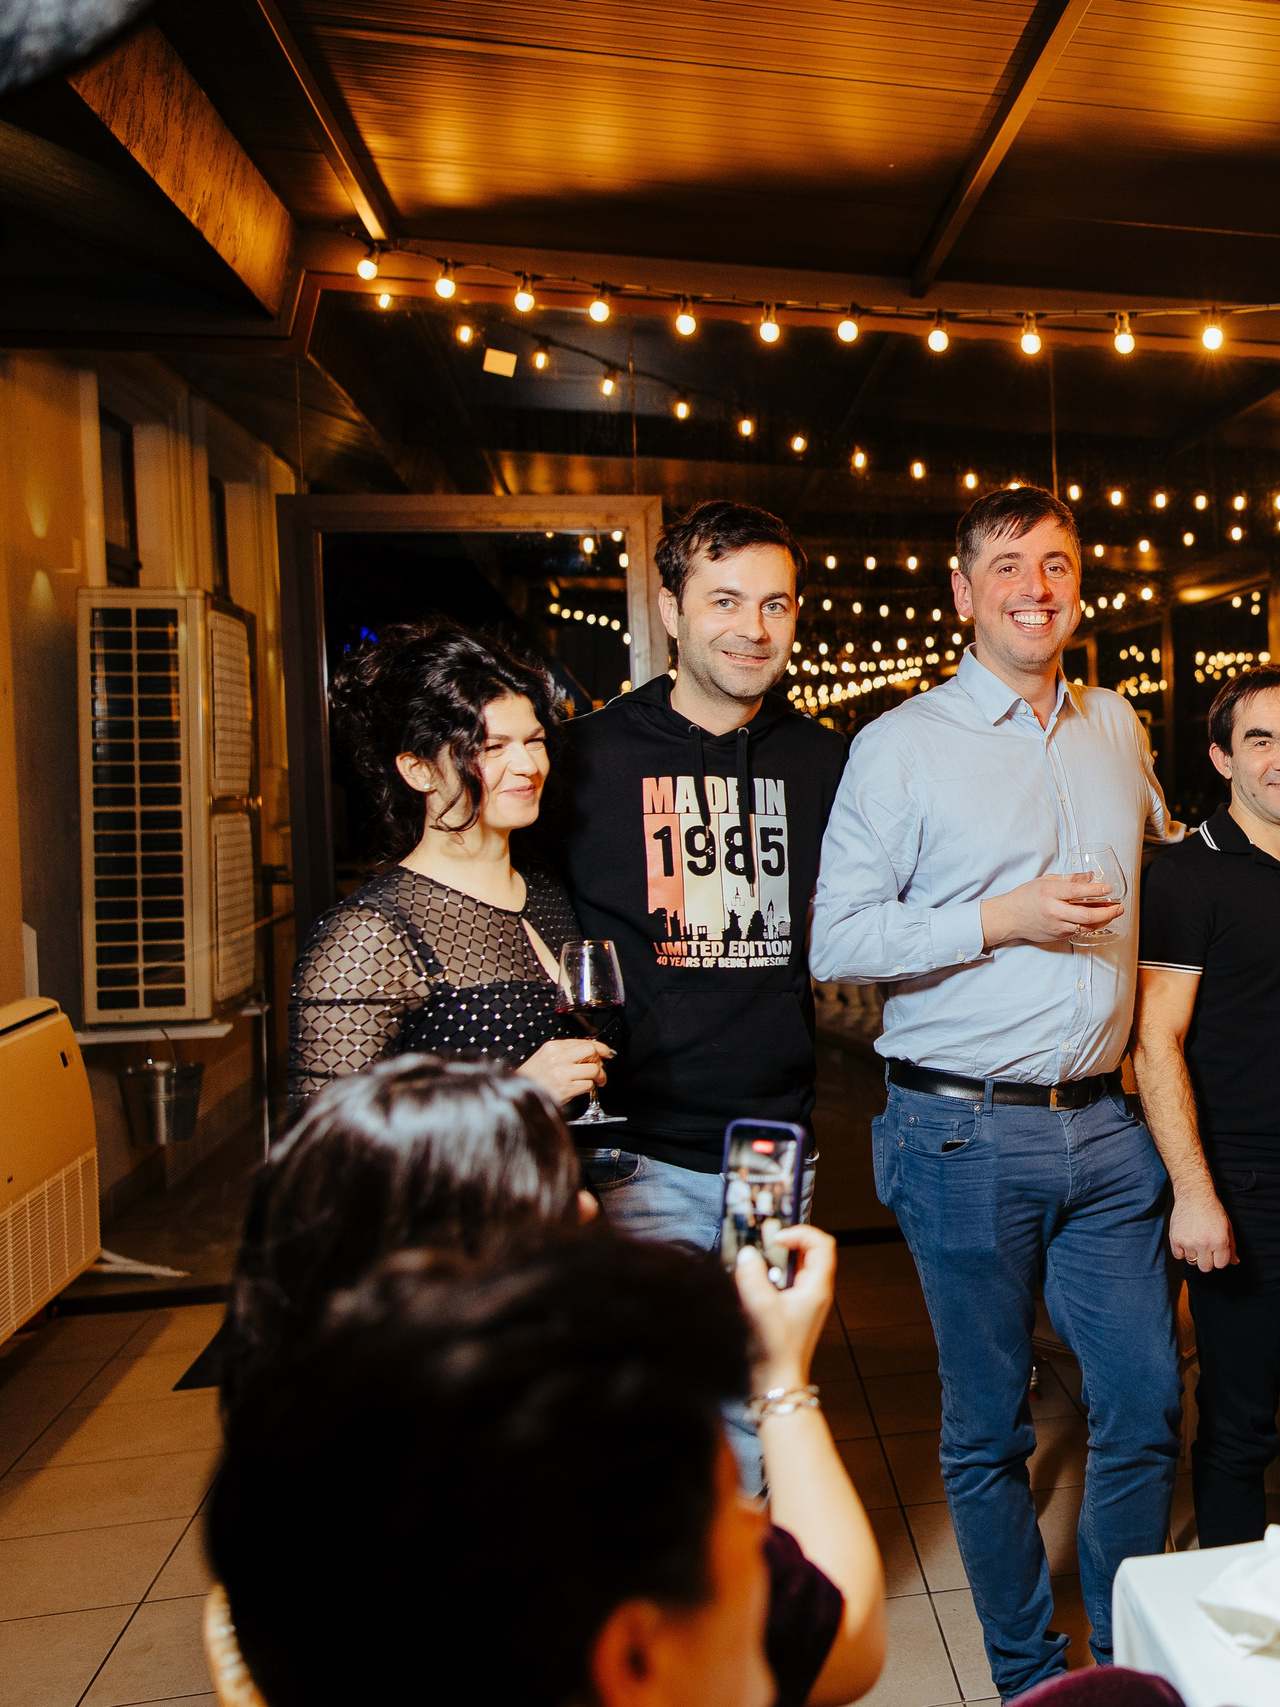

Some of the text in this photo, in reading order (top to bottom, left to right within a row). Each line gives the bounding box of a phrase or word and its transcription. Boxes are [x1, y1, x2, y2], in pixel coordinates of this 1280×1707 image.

[642, 776, 787, 816] MADE IN
[653, 825, 786, 877] 1985
[653, 940, 792, 957] LIMITED EDITION
[656, 955, 790, 969] 40 YEARS OF BEING AWESOME
